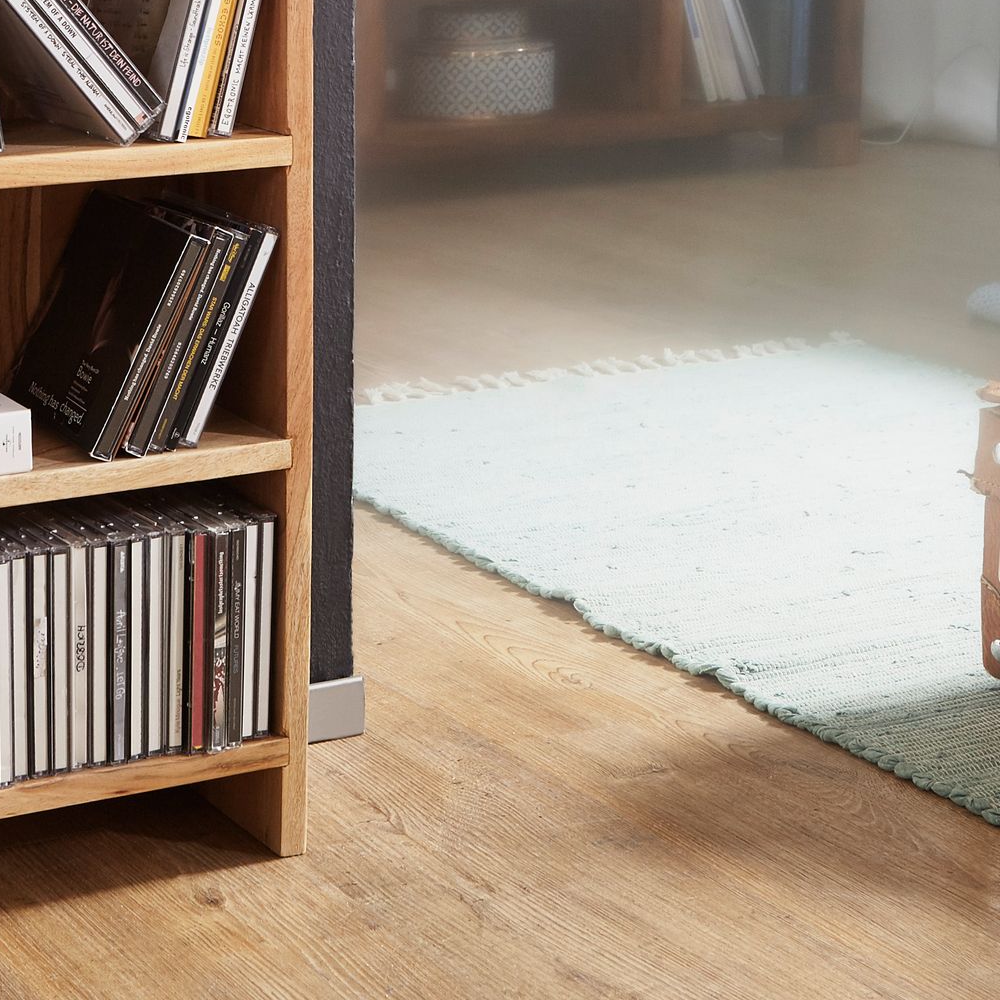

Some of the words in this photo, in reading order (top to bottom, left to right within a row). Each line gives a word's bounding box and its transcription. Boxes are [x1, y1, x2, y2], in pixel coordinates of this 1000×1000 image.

[20, 1, 40, 24] SYSTEM
[38, 22, 47, 30] OF
[47, 34, 62, 51] DOWN
[61, 50, 76, 69] STEAL
[51, 6, 60, 16] OF
[61, 20, 78, 39] DOWN
[70, 3, 85, 17] DIE
[81, 14, 105, 41] NATUR
[99, 37, 114, 51] IST
[109, 49, 126, 69] DEIN
[122, 64, 142, 88] FEIND
[221, 79, 240, 126] EGOTRONIC
[235, 50, 245, 74] MACHT
[240, 22, 251, 49] KEINEN
[180, 105, 192, 140] egotronic
[210, 296, 218, 310] STAR
[215, 301, 231, 328] Gorillaz
[230, 281, 256, 335] ALLIGATOAH
[200, 336, 217, 366] Humanz
[208, 338, 235, 391] TRIEBWERKE
[28, 380, 50, 406] Nothing
[47, 394, 60, 410] has
[173, 380, 184, 400] MACHT
